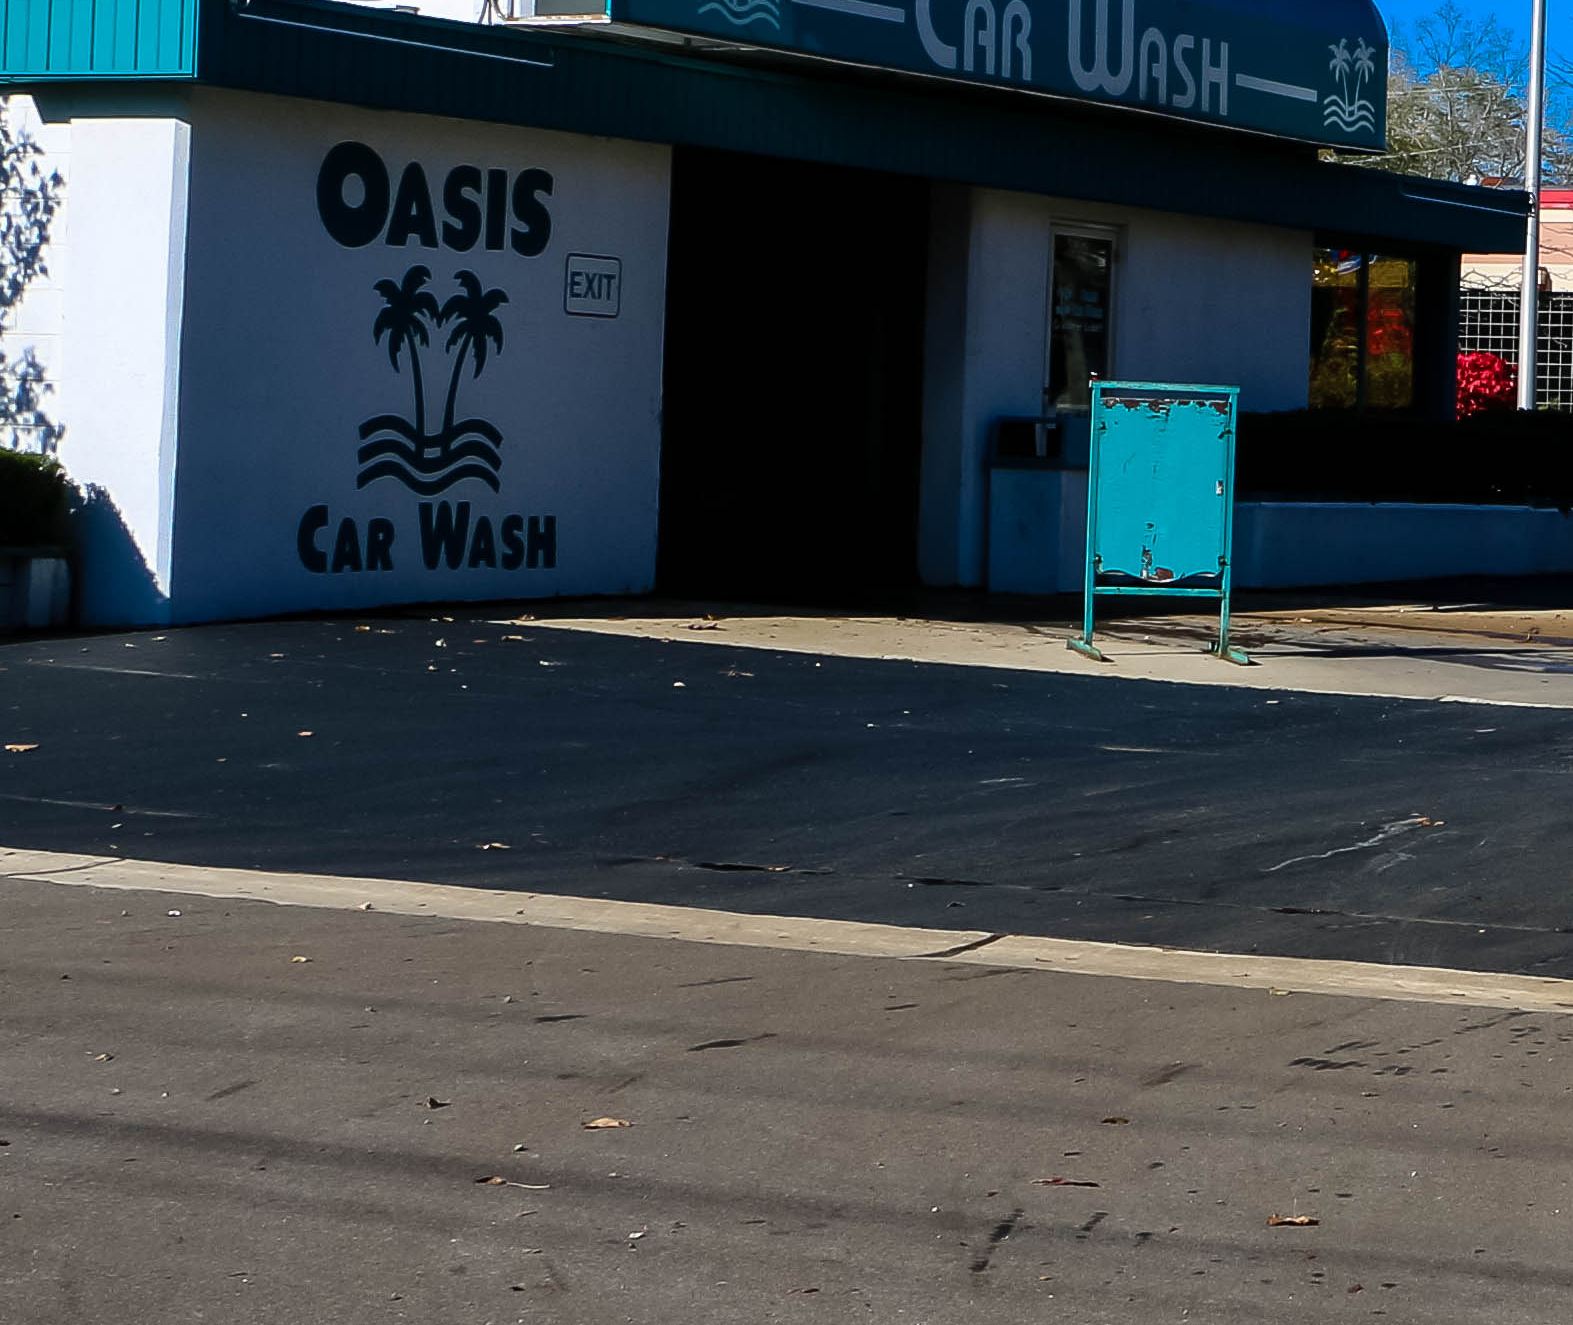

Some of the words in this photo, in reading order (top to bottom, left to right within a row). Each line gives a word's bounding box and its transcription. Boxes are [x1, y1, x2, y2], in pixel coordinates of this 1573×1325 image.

[316, 140, 555, 258] OASIS
[568, 270, 617, 303] EXIT
[298, 505, 394, 574] CAR
[418, 500, 558, 572] WASH
